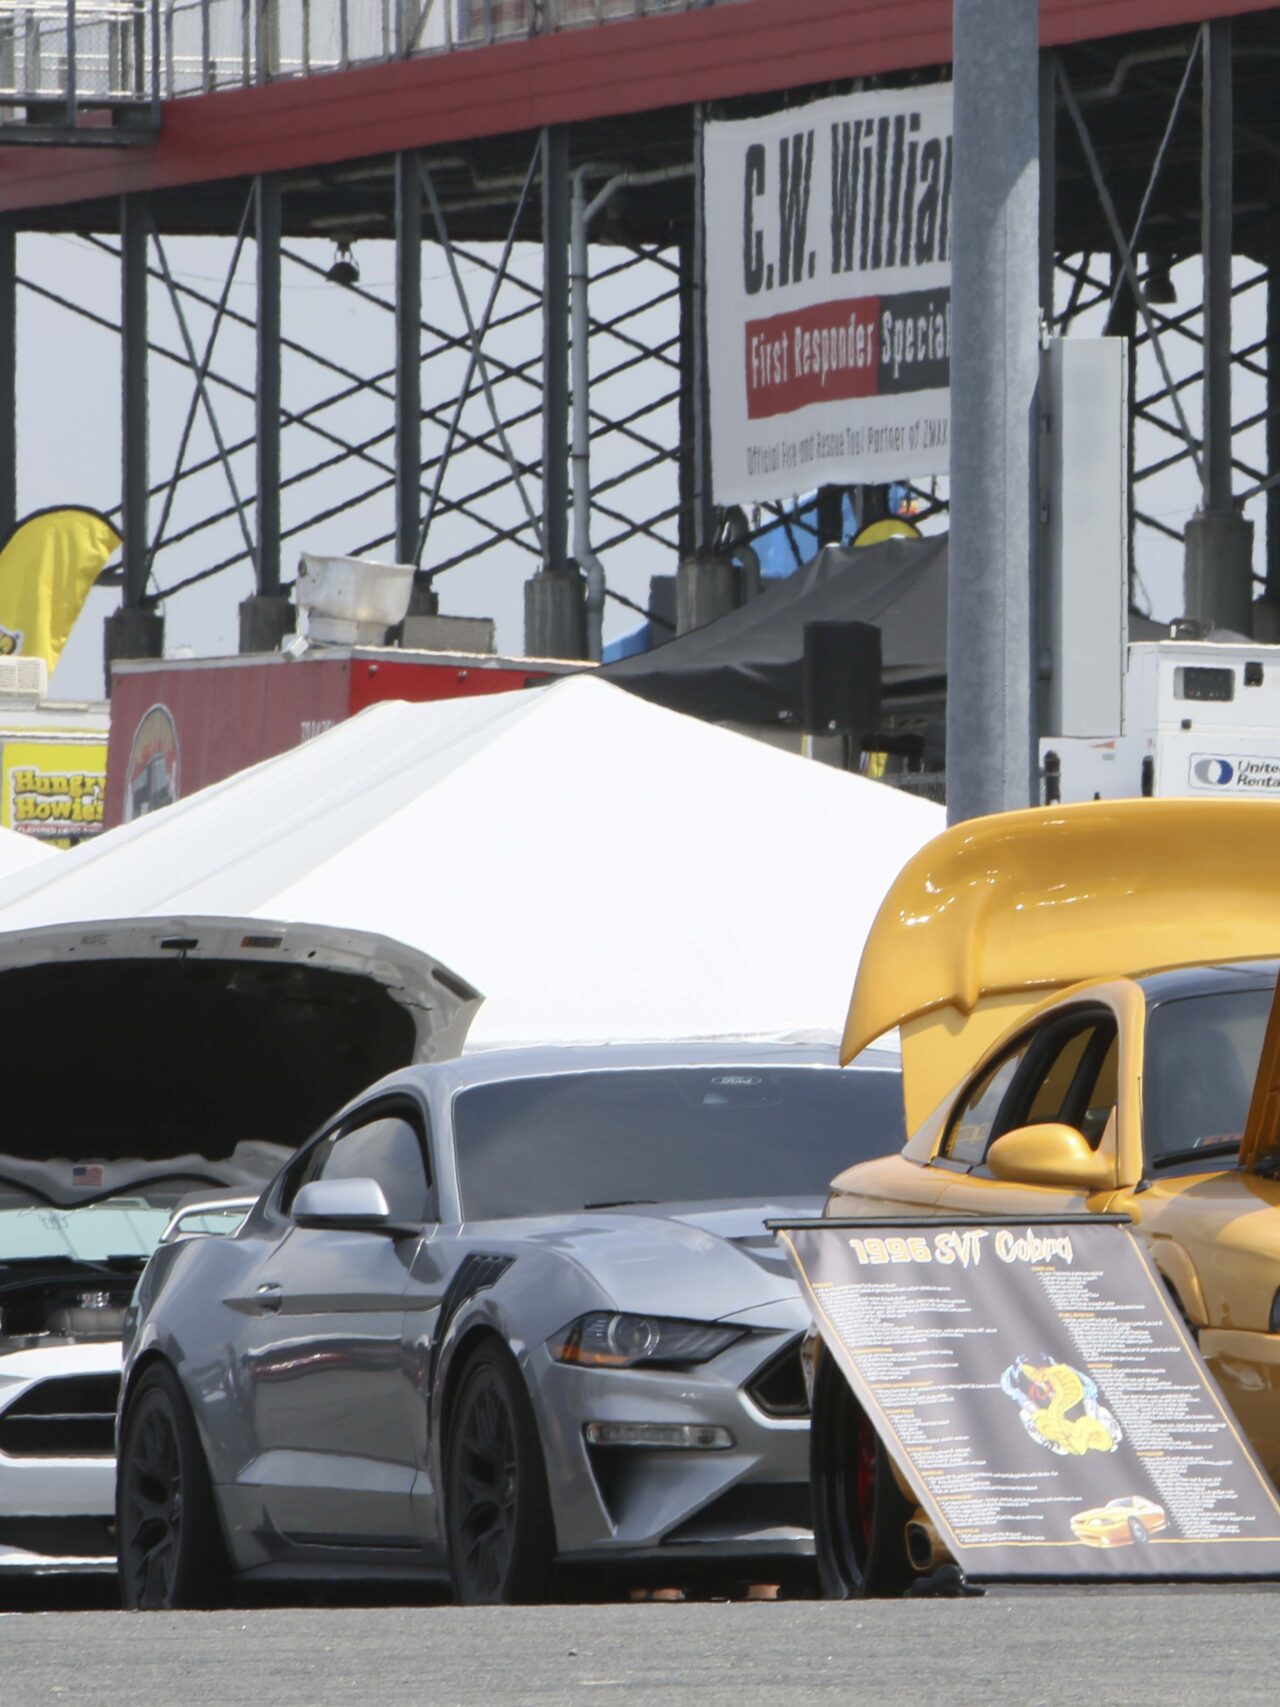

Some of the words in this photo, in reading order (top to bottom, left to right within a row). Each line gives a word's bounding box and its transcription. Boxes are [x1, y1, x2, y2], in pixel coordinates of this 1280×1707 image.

[744, 129, 816, 295] C.W.
[752, 331, 789, 390] First
[795, 312, 874, 388] Responder
[868, 425, 905, 454] Partner
[909, 420, 920, 448] of
[849, 1237, 932, 1264] 1996
[935, 1230, 990, 1268] SVT
[995, 1227, 1073, 1265] Cobra
